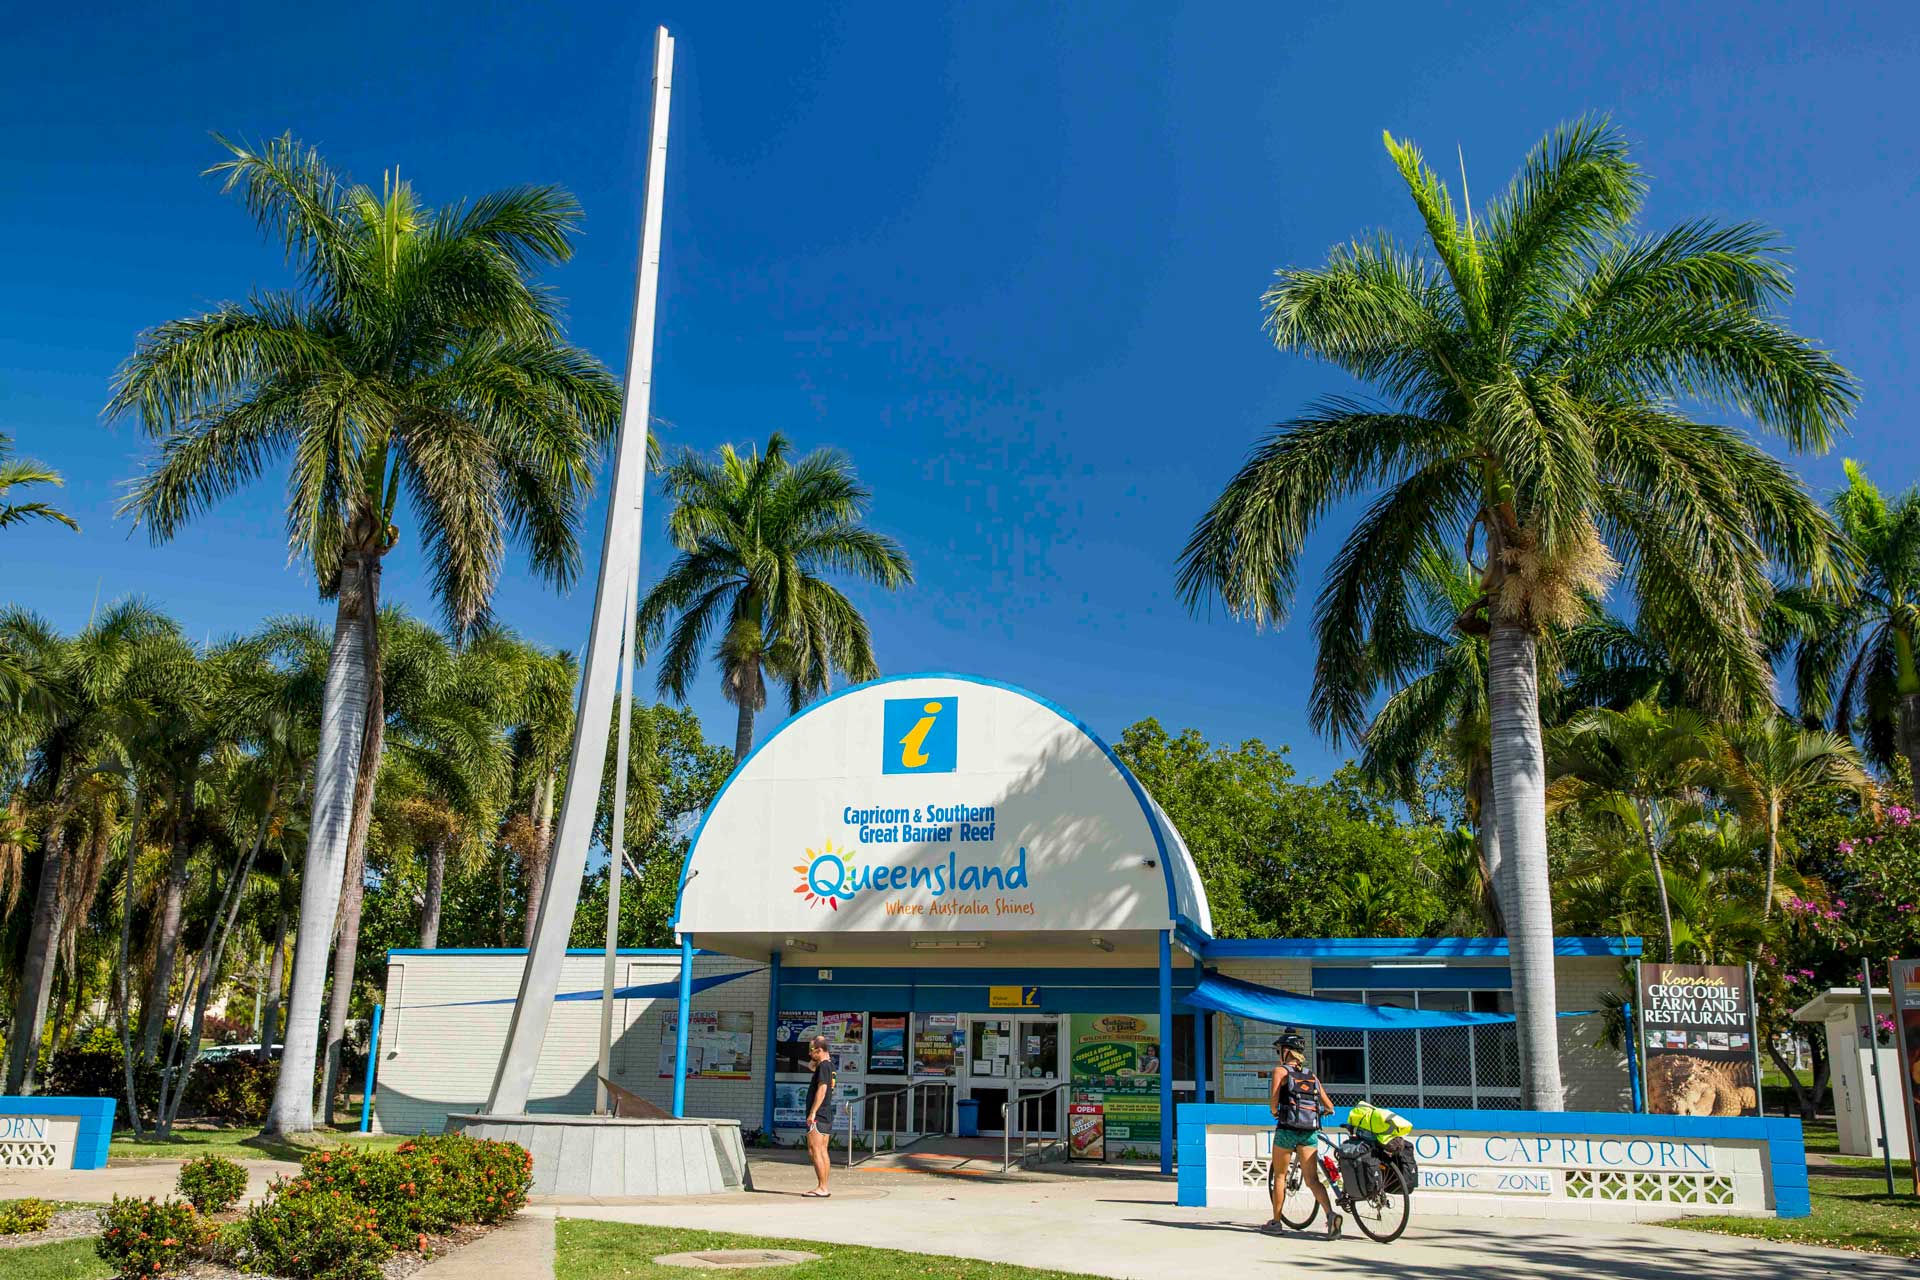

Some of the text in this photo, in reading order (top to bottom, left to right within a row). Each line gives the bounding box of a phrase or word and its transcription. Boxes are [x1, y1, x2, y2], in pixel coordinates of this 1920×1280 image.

[844, 804, 995, 826] Capricorn & Southern
[860, 823, 996, 844] Great Barrier Reef
[809, 846, 1029, 900] Queensland
[887, 896, 1035, 916] Where Australia Shines
[1663, 969, 1726, 987] Koorana
[1649, 984, 1740, 1000] CROCODILE
[1653, 997, 1737, 1013] FARM AND
[1645, 1009, 1747, 1026] RESTAURANT
[1076, 1105, 1097, 1113] OPEN
[1415, 1133, 1711, 1169] OF CAPRICORN
[1498, 1174, 1551, 1191] ZONE
